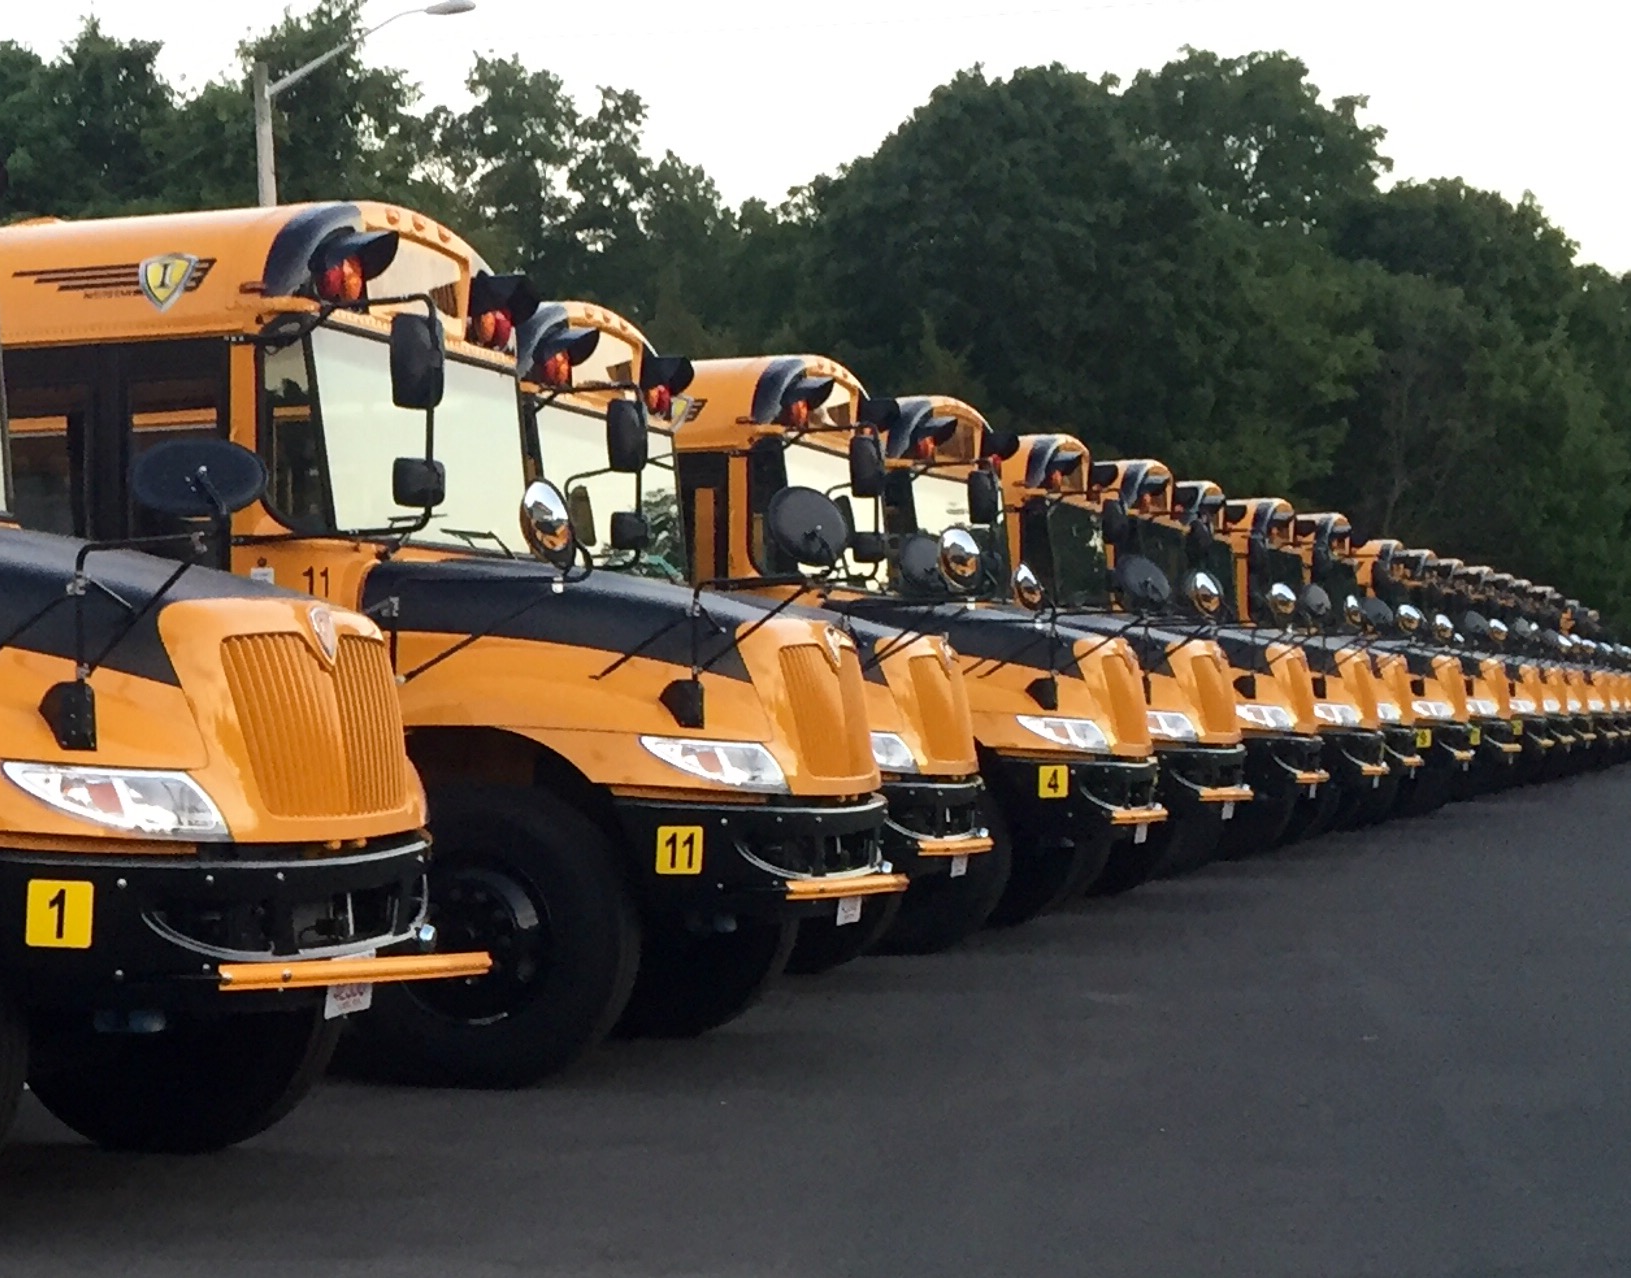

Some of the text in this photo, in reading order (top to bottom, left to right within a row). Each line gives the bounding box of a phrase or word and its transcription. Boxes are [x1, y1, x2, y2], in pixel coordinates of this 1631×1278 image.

[302, 565, 330, 598] 11
[1047, 769, 1060, 794] 4
[665, 831, 695, 870] 11
[49, 888, 66, 940] 1
